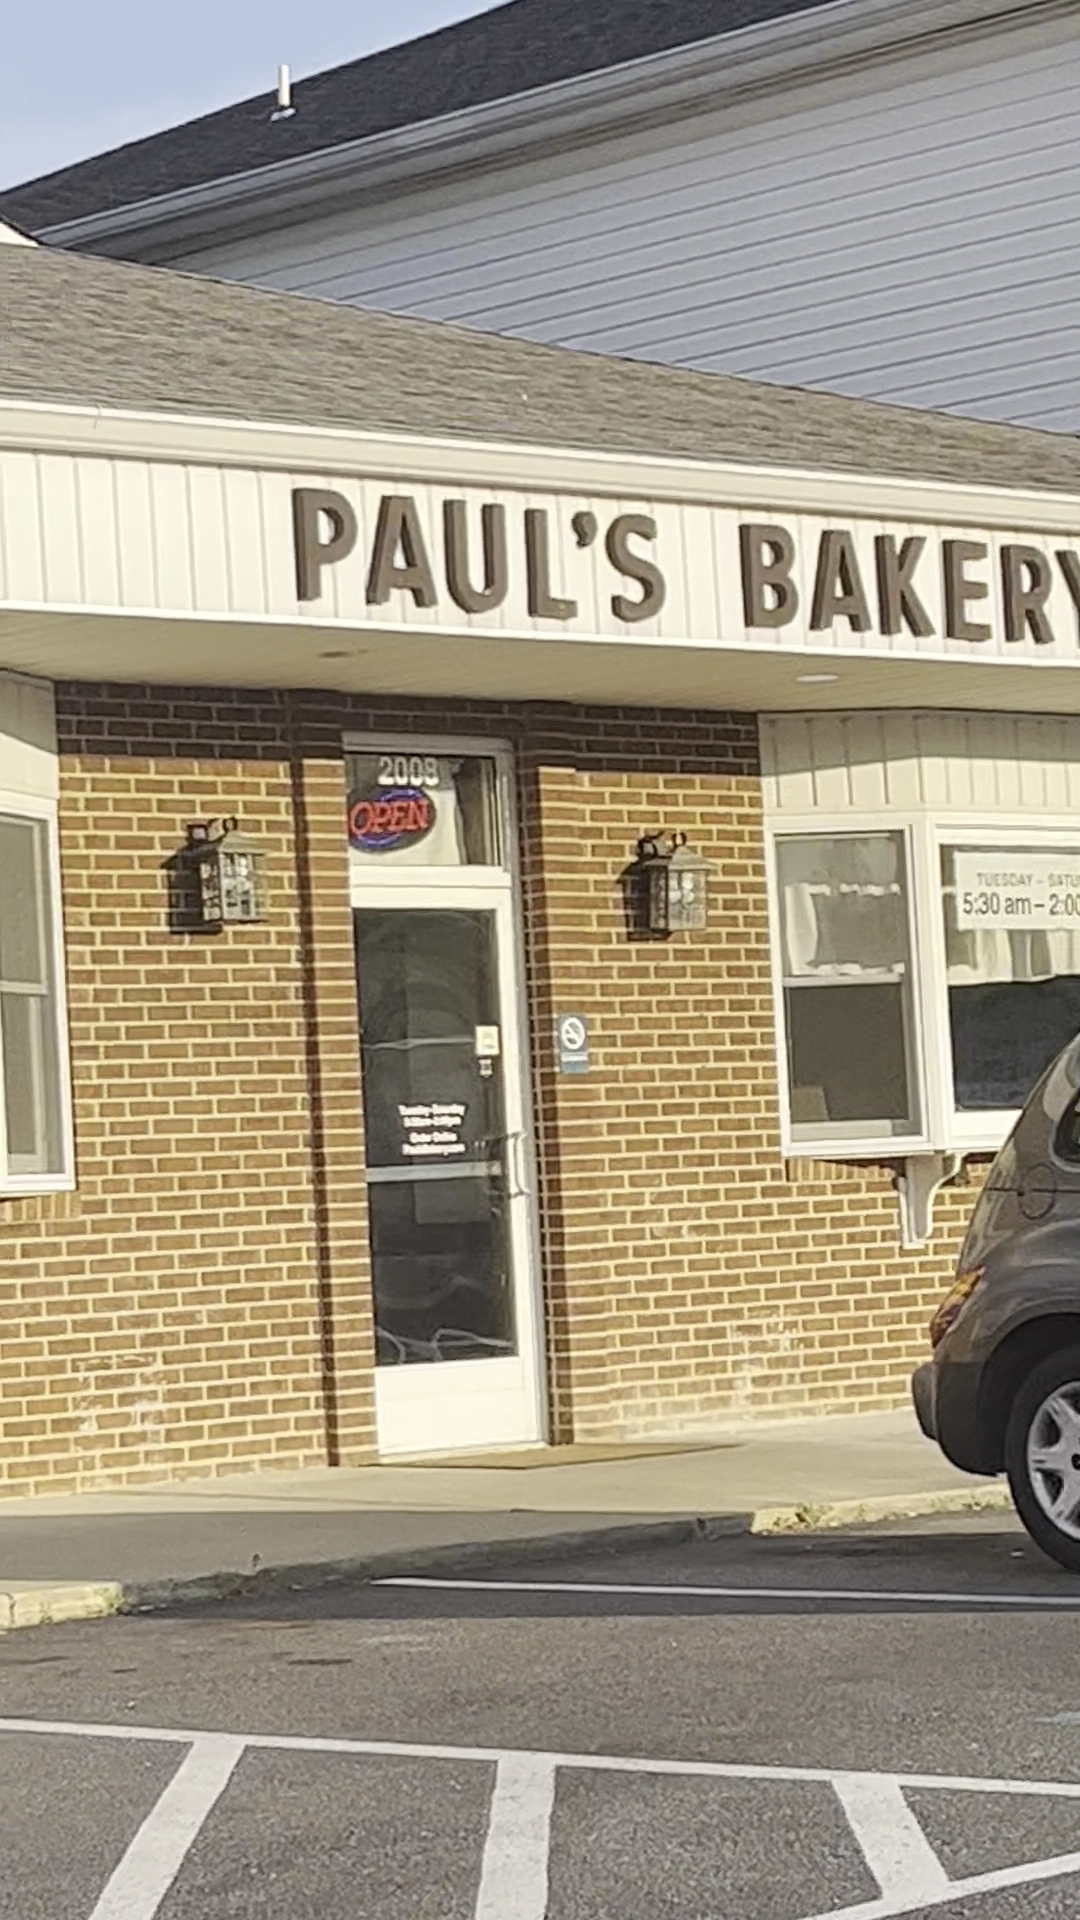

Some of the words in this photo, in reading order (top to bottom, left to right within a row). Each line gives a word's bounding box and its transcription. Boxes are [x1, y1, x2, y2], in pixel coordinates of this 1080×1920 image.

[292, 488, 666, 623] PAUL'S
[378, 757, 439, 786] 2008
[350, 798, 430, 834] OPEN
[976, 871, 1033, 887] TUESDAY
[963, 892, 1001, 915] 5:30
[1004, 897, 1032, 915] am
